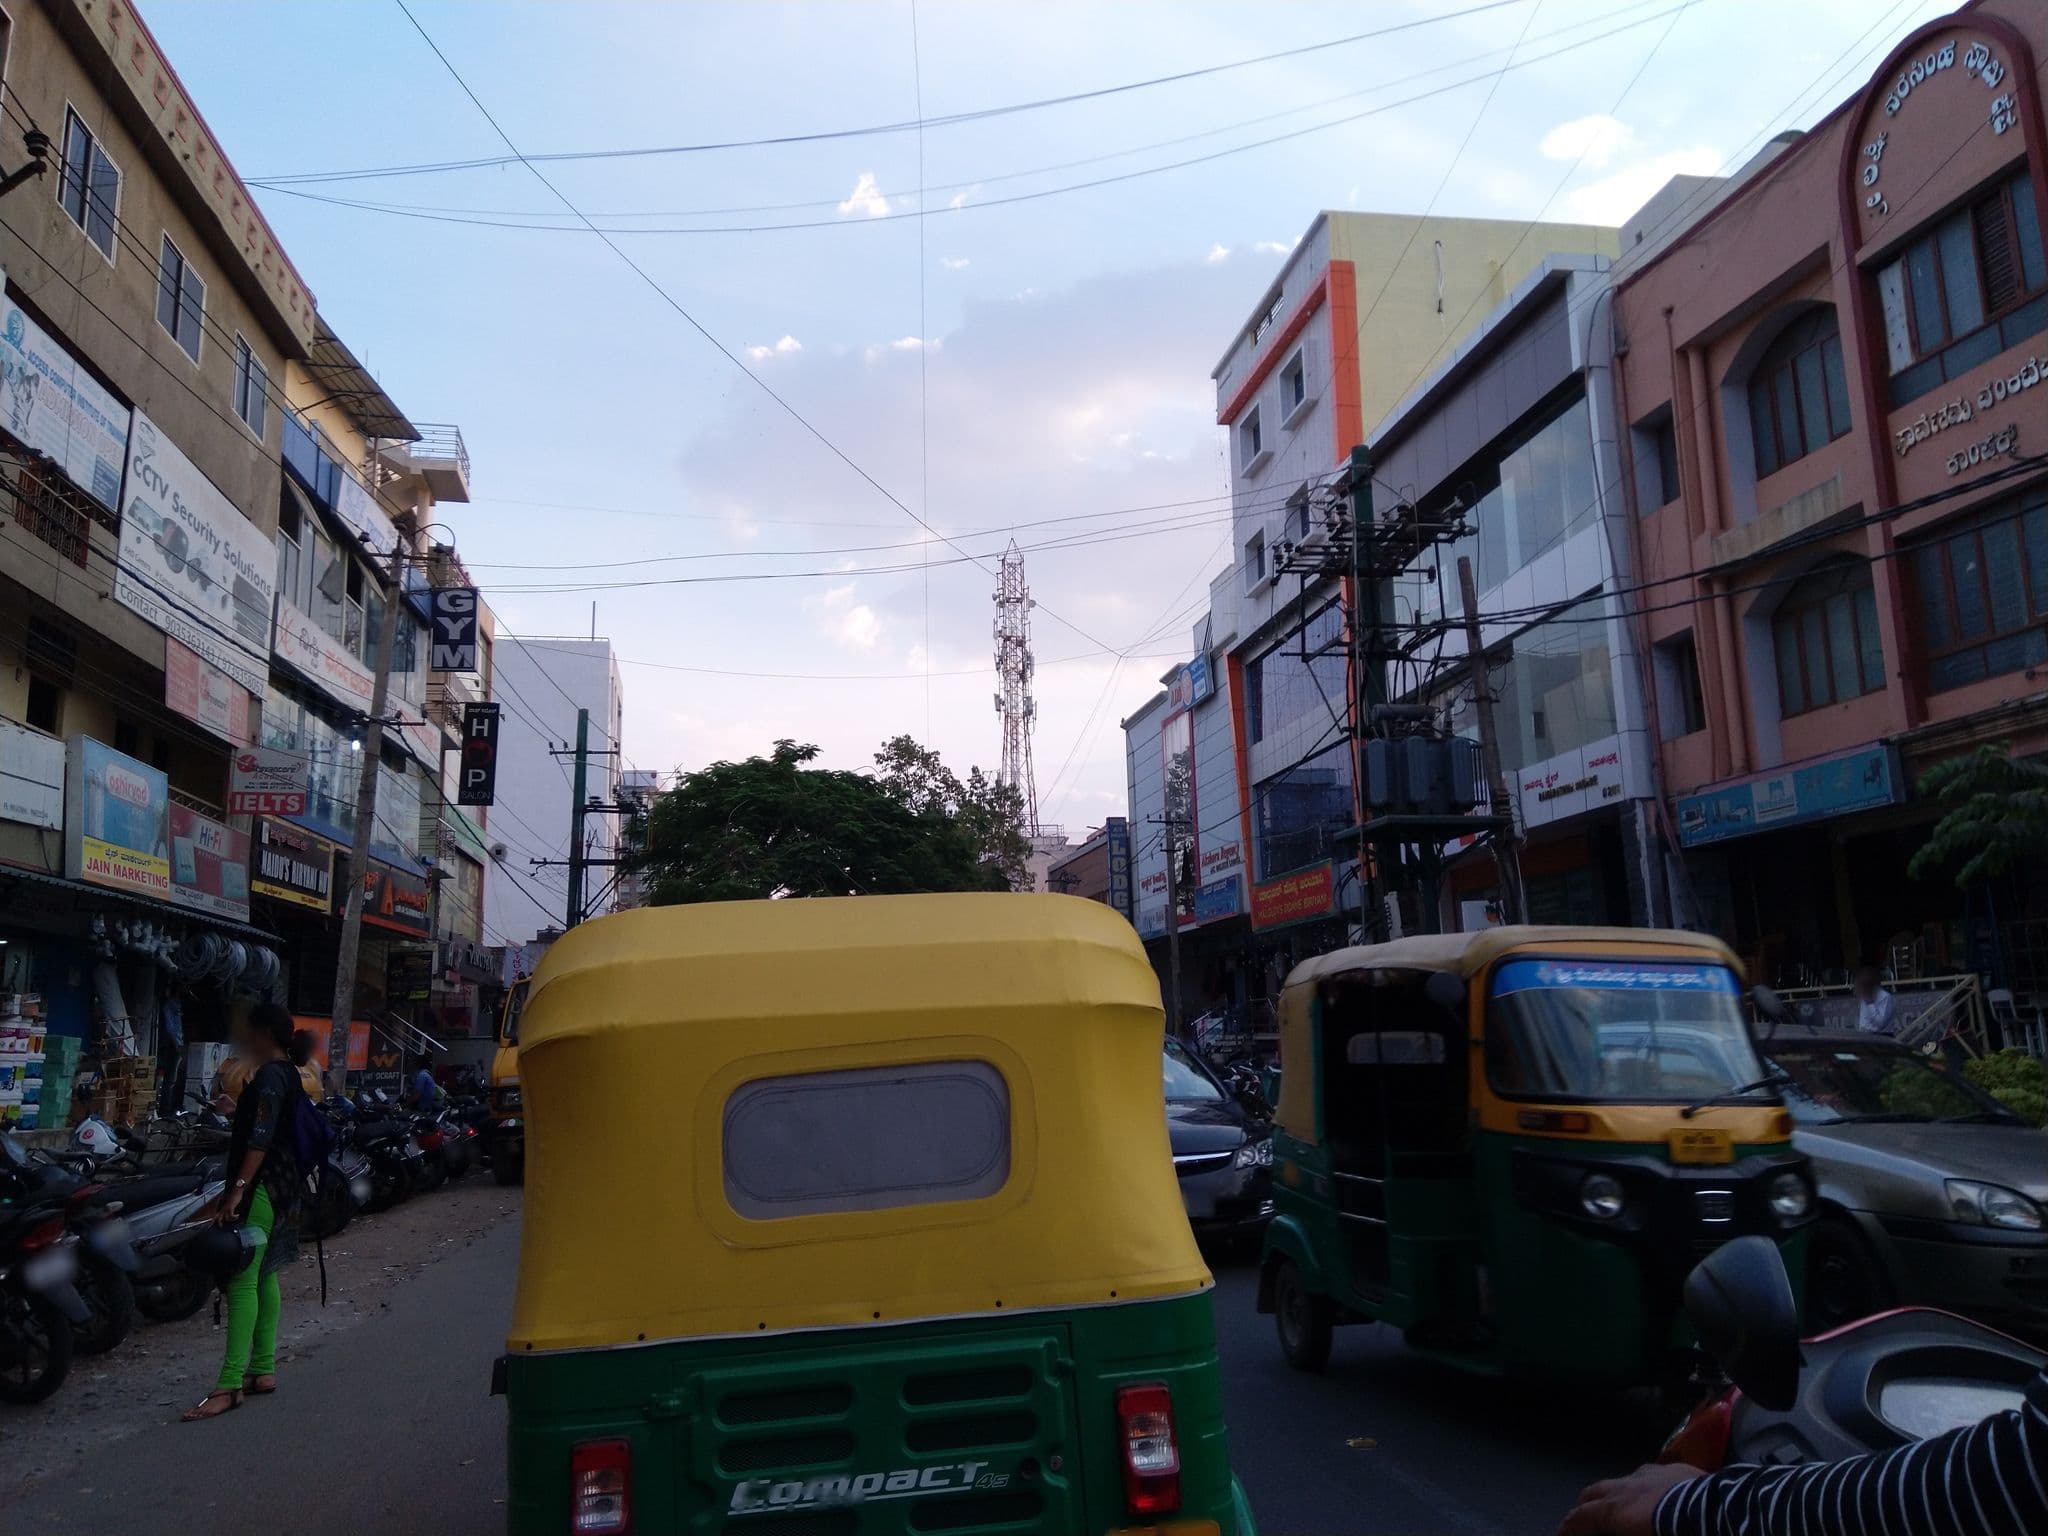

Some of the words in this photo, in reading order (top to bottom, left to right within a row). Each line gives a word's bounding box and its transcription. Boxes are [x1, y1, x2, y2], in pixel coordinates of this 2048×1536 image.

[132, 454, 170, 501] CCTV
[171, 490, 221, 555] Security
[223, 540, 272, 597] Solutions
[120, 583, 158, 623] Contact
[433, 590, 475, 668] GYM
[234, 794, 300, 812] IELTS
[463, 790, 491, 800] SALON
[199, 825, 222, 851] Hi-Fi
[87, 857, 110, 875] JAIN
[113, 863, 168, 889] MARKETING
[262, 849, 290, 882] NAIDU'S
[291, 860, 318, 891] BIRYANI
[730, 1462, 988, 1510] Compact
